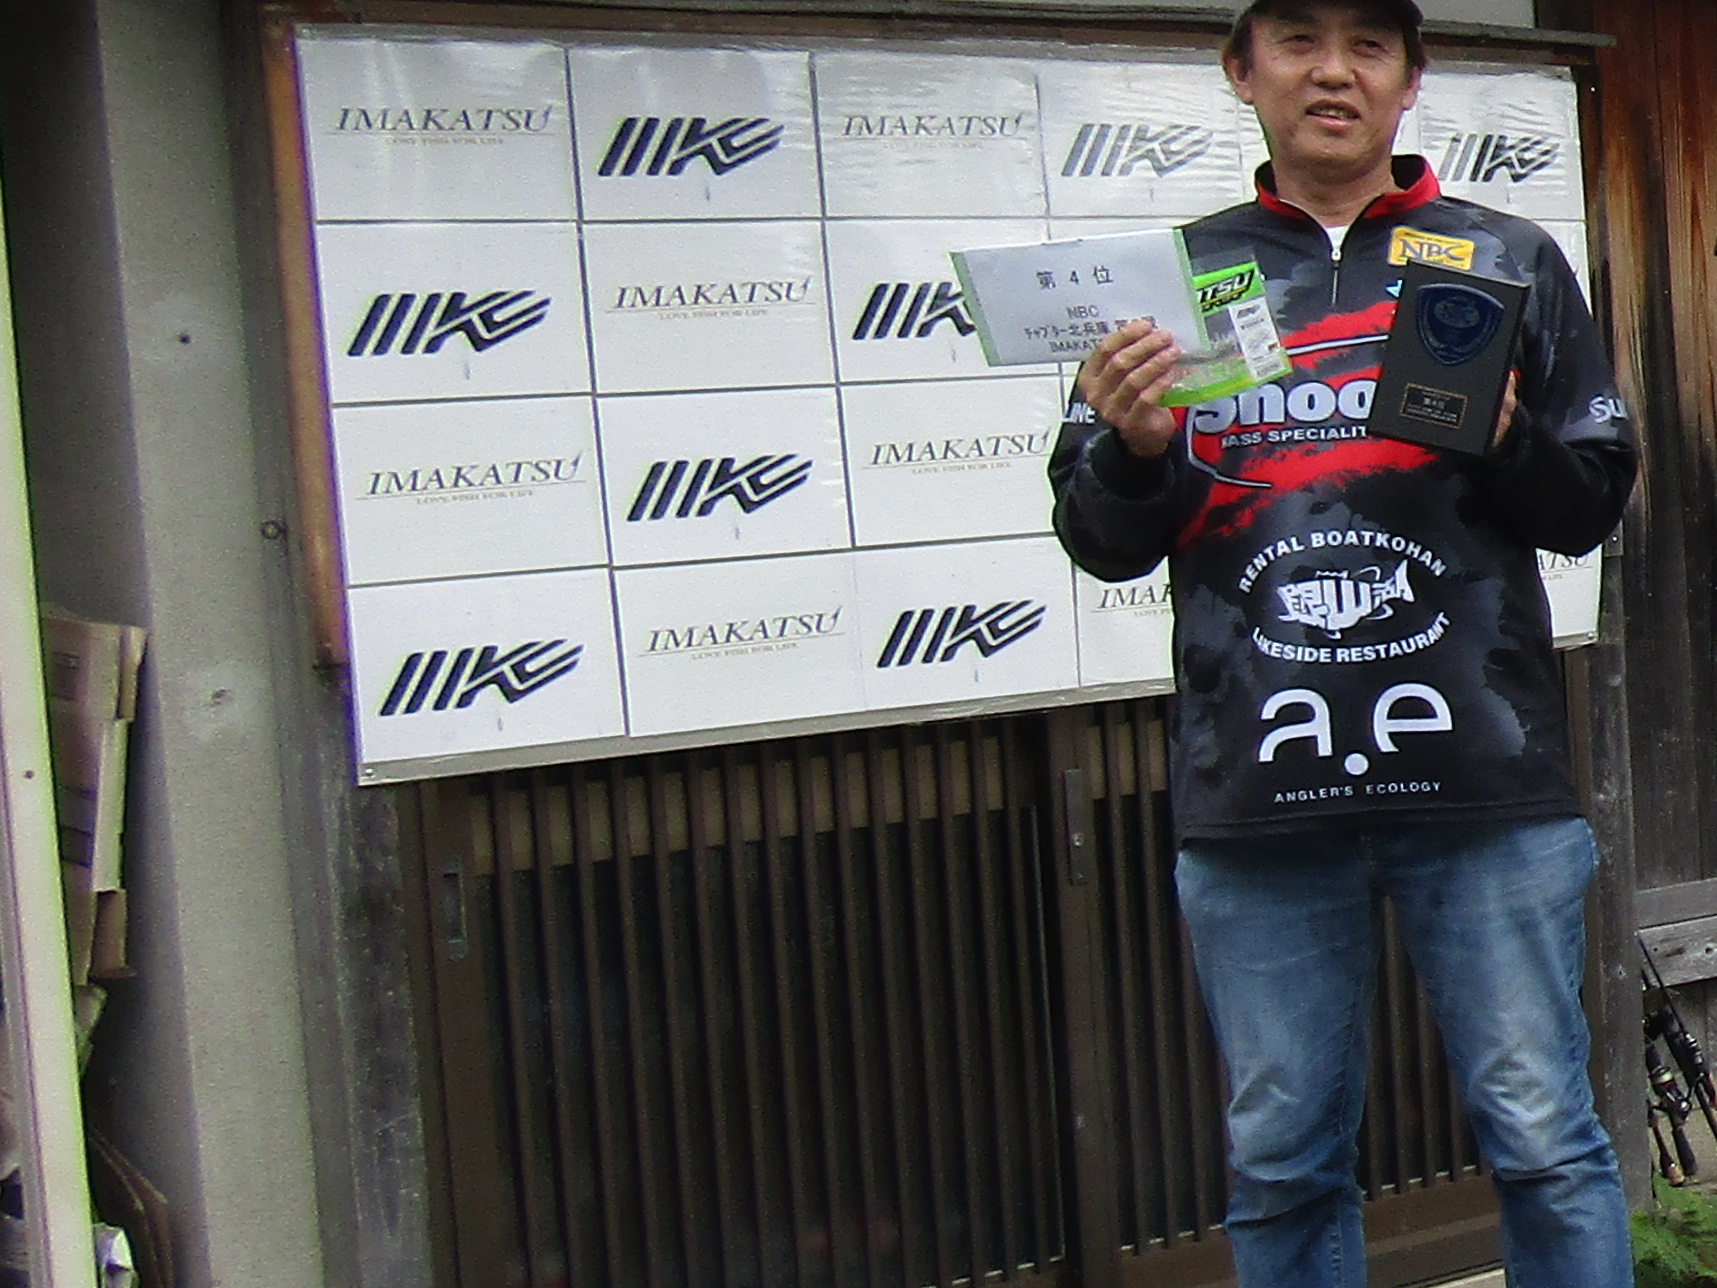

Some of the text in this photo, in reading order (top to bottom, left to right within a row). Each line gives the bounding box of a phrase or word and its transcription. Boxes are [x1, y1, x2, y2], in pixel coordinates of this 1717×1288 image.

[337, 105, 553, 132] IMAKATSU
[841, 112, 1023, 138] IMAKATSU
[1399, 239, 1466, 263] NBC
[614, 276, 812, 309] IMAKATSU
[1066, 305, 1100, 320] NBC
[870, 430, 1050, 466] IMAKATSU
[367, 451, 583, 496] IMAKATSU
[1239, 535, 1306, 594] RENTAL
[646, 605, 843, 653] IMAKATSU
[1336, 611, 1451, 663] RESTAURANT
[1273, 781, 1442, 804] ANGLER'S ECOLOGY
